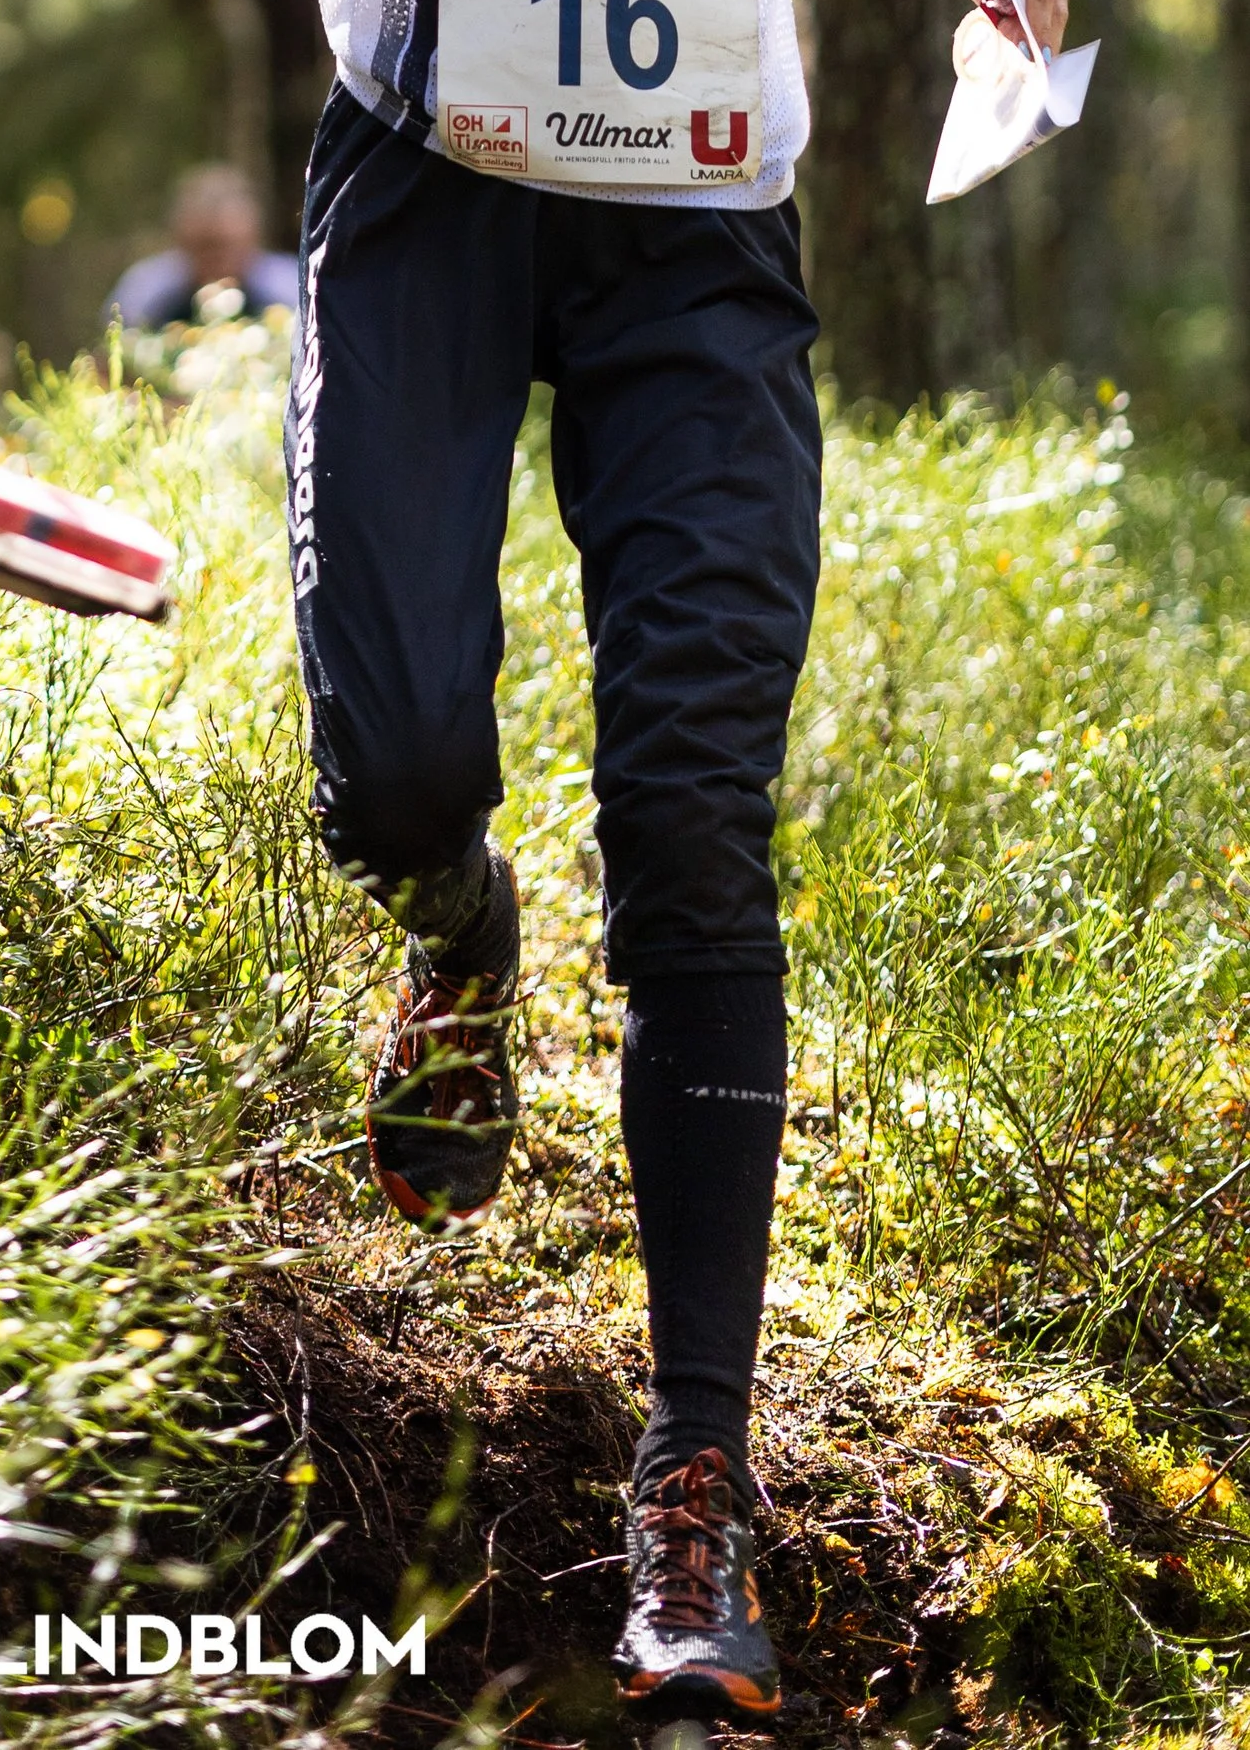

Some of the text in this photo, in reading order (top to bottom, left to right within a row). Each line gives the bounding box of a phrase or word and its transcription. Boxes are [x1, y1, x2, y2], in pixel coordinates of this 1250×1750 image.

[546, 112, 671, 149] Ullmax
[454, 134, 523, 153] Tisaren
[690, 169, 744, 180] UMARA
